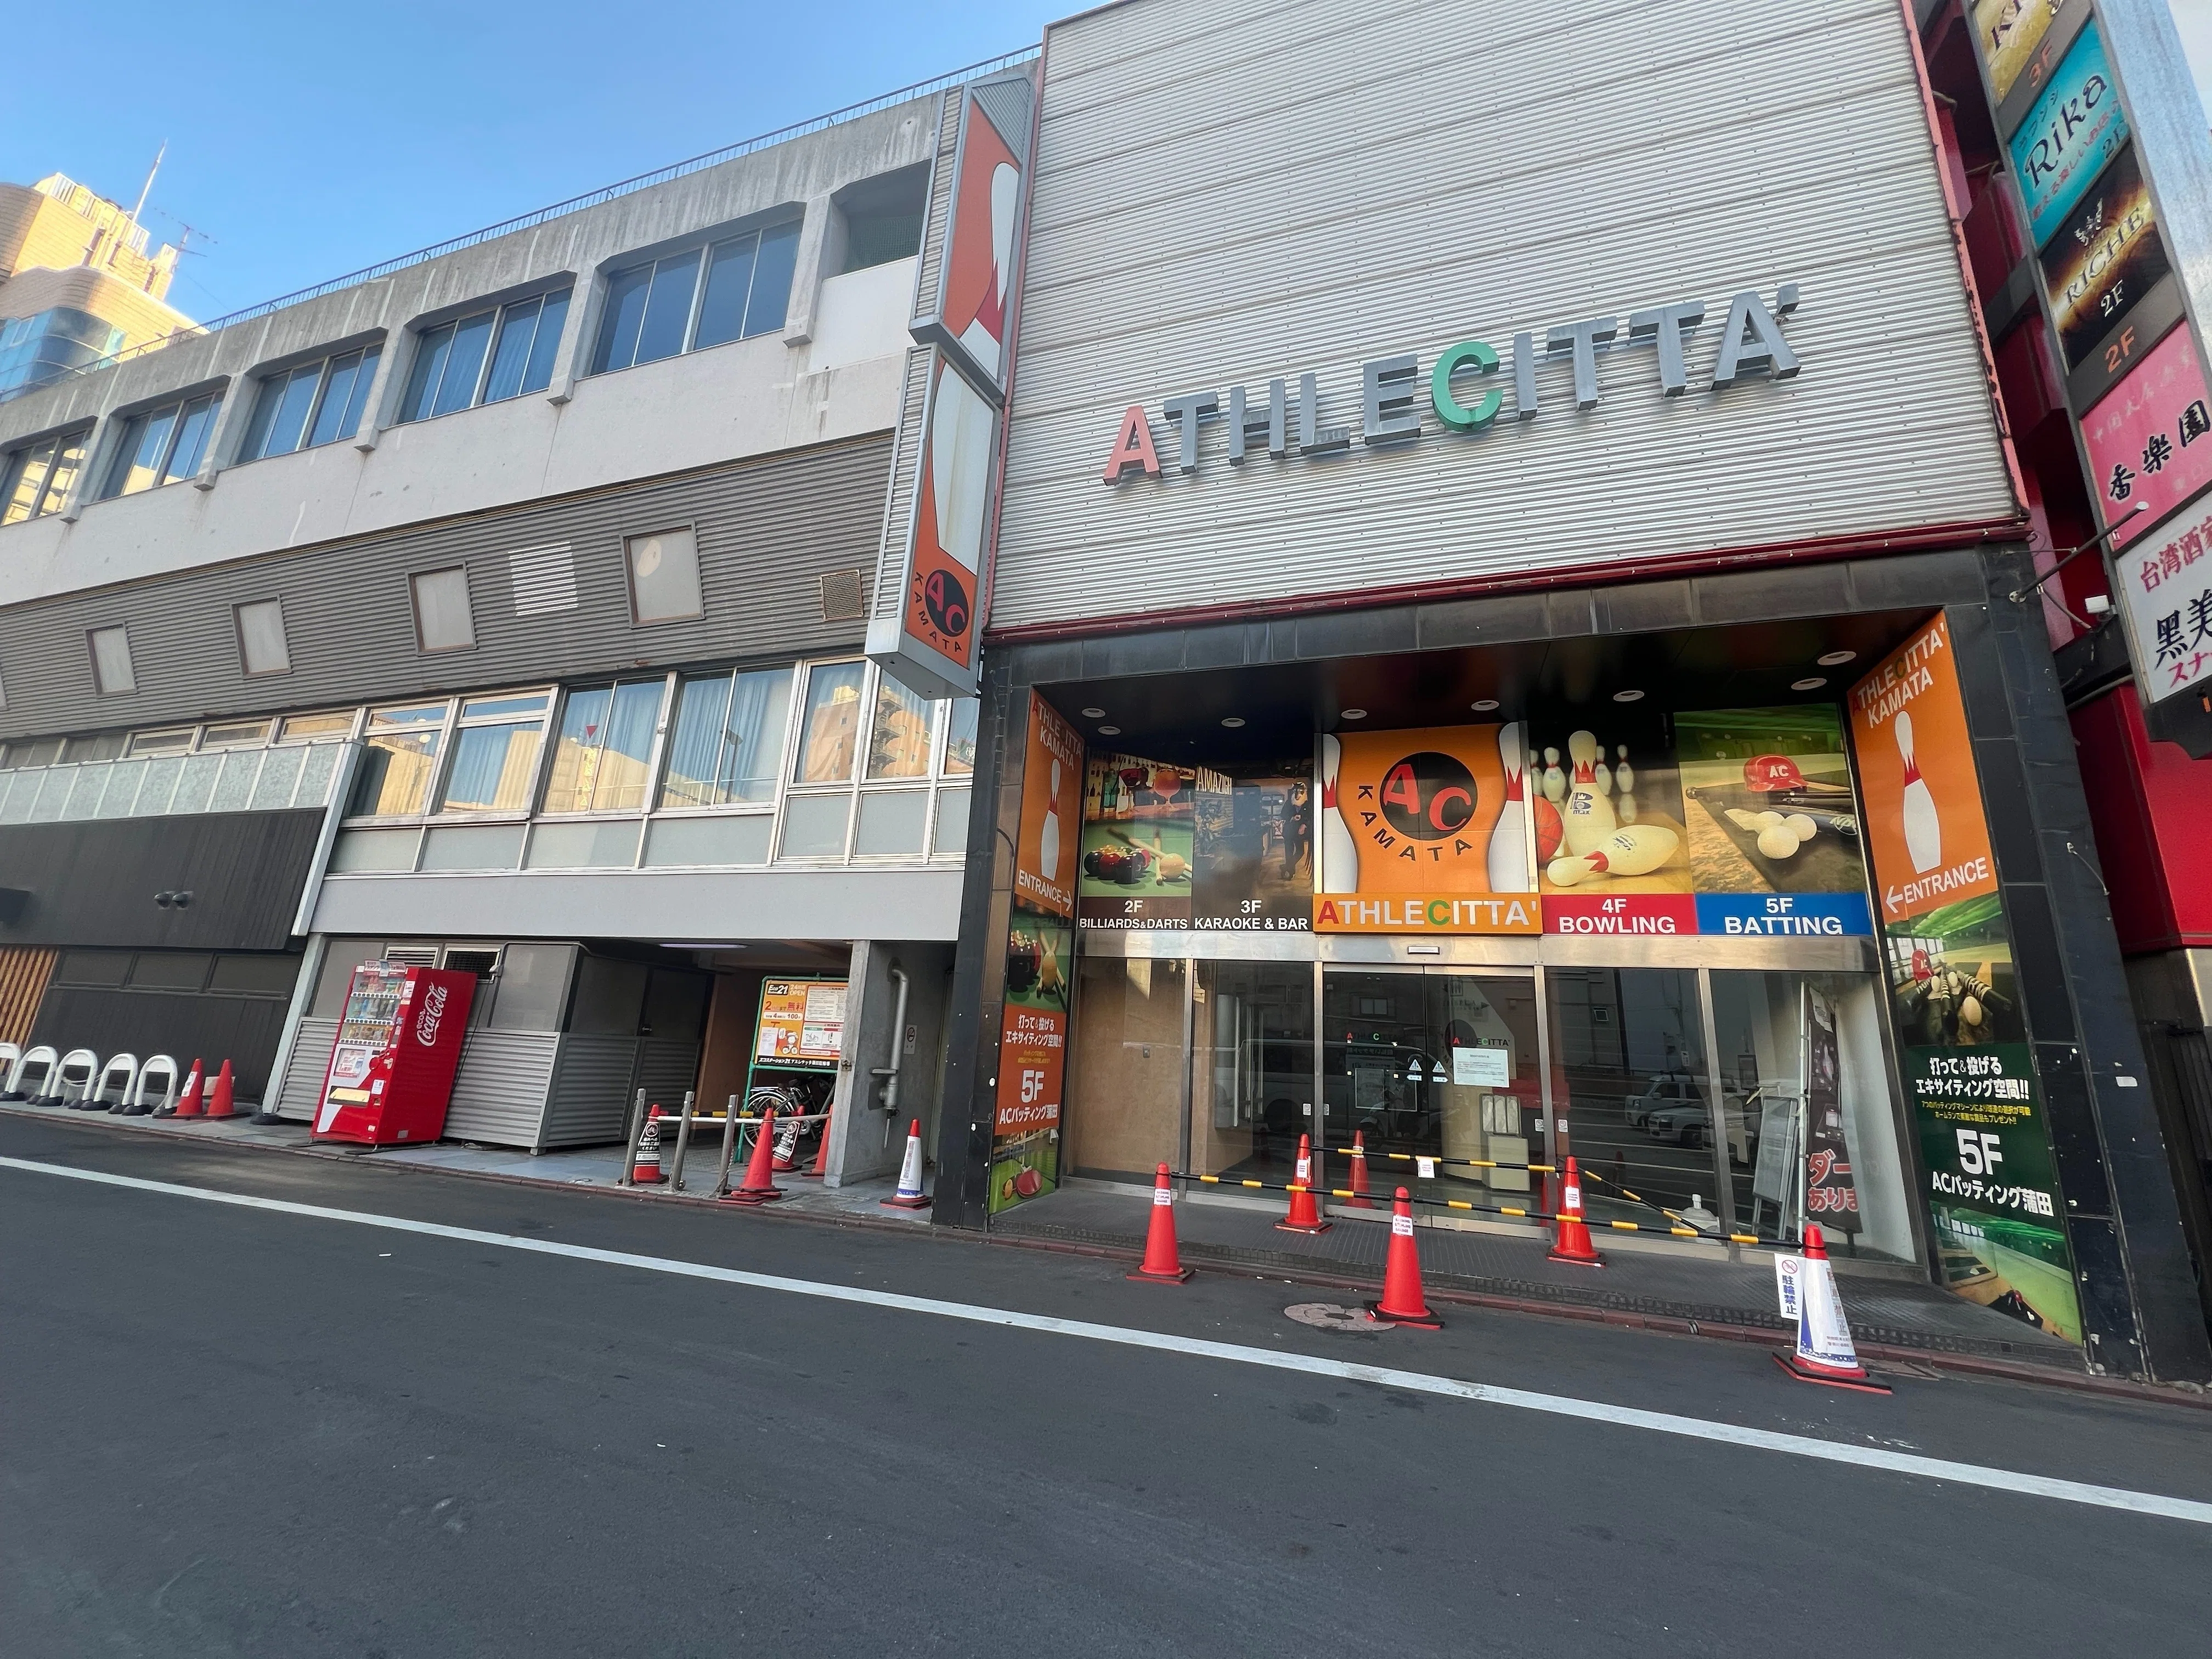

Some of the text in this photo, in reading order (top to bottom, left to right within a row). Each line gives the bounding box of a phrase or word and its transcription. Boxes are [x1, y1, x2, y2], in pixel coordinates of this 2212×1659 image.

[2025, 75, 2107, 188] Rika
[2064, 204, 2145, 304] RICHE
[2101, 280, 2125, 317] 2F
[2104, 325, 2136, 373] 2F
[914, 571, 962, 652] KAMATA
[2168, 650, 2212, 689] スナ
[1867, 666, 1934, 729] KAMATA
[1040, 725, 1075, 771] KAMATA
[1196, 765, 1232, 795] AMAZIGH
[1769, 765, 1789, 778] AC
[1383, 764, 1472, 831] AC
[1358, 785, 1473, 861] KAMATA
[1018, 869, 1062, 904] ENTRANCE
[1904, 857, 1989, 904] ENTRANCE
[1125, 900, 1143, 913] 2F
[1194, 917, 1308, 930] KARAOKE & BAR
[1240, 900, 1262, 913] 3F
[1601, 898, 1627, 913] 4F
[1765, 898, 1793, 913] 5F
[1559, 916, 1676, 934] BOWLING
[1724, 916, 1843, 935] BATTING
[1021, 1070, 1045, 1103] 5F
[1956, 1128, 2003, 1175] 5F
[1932, 1171, 2054, 1217] ACバッティング蒲田
